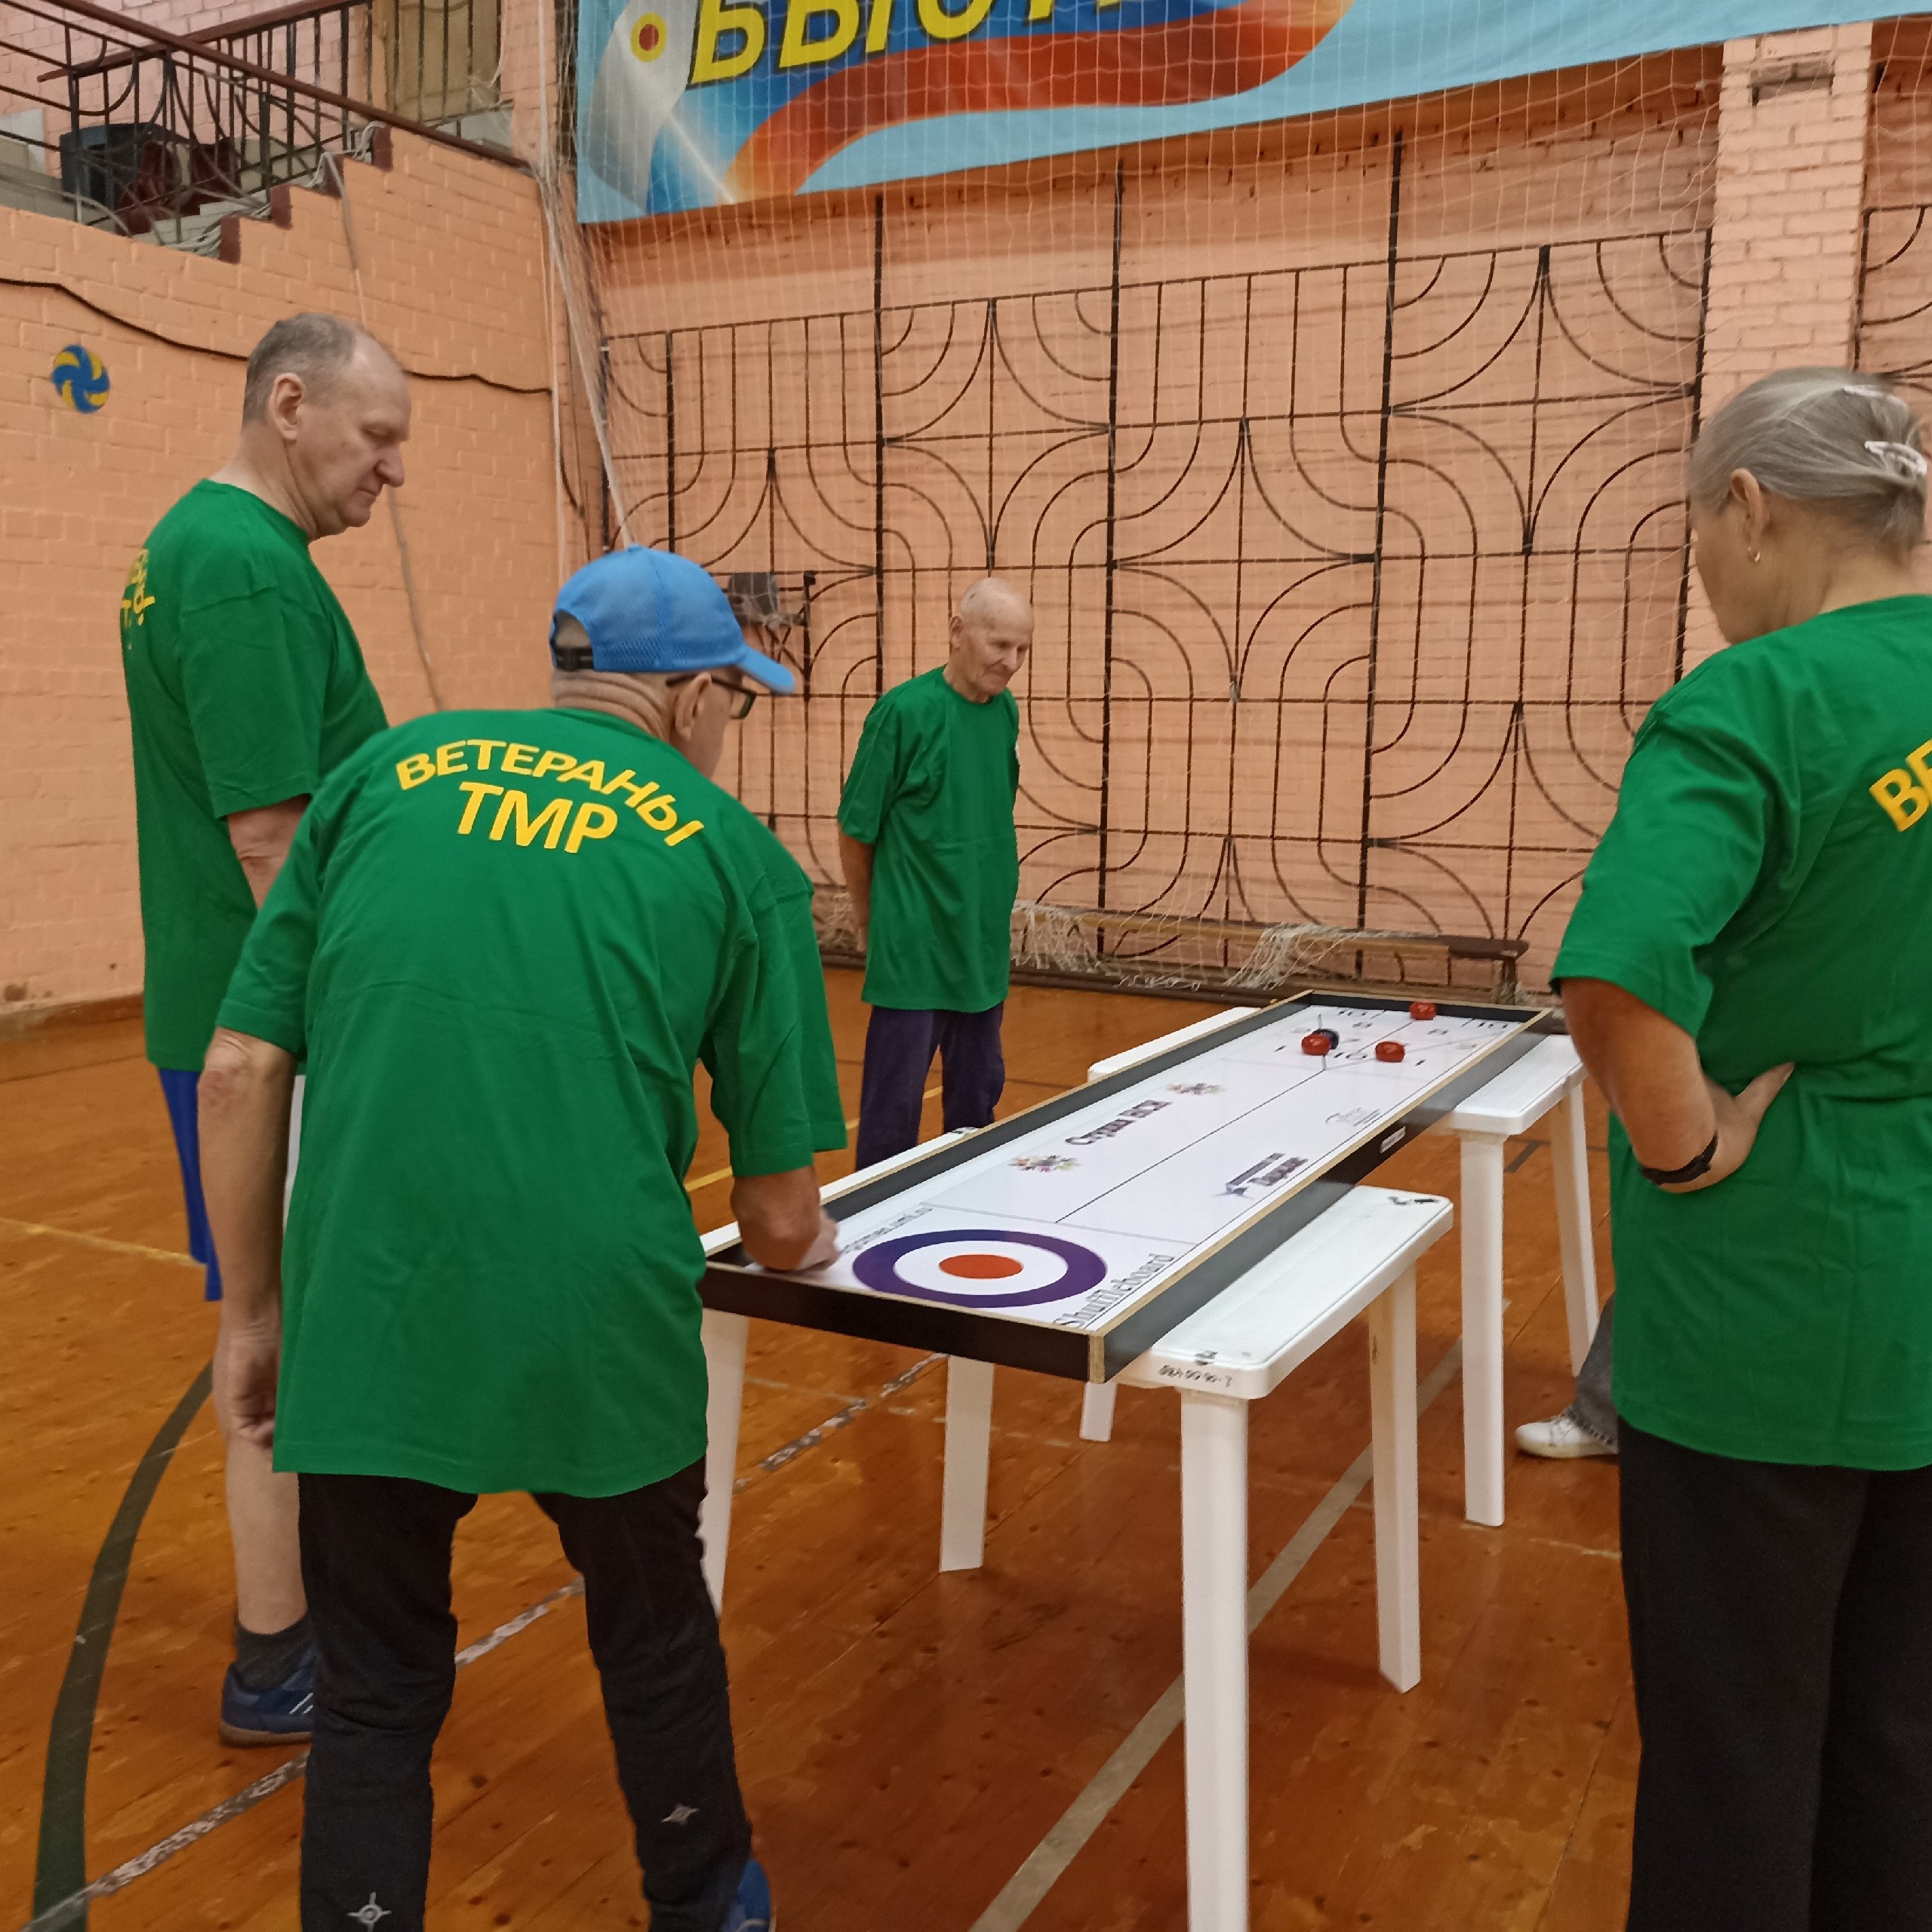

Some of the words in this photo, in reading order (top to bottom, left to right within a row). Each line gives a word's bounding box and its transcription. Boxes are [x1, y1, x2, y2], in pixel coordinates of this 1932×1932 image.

[396, 739, 704, 847] ВЕТЕРАНЫ
[457, 781, 618, 854] ТМР
[1052, 1252, 1176, 1329] Shuffleboard
